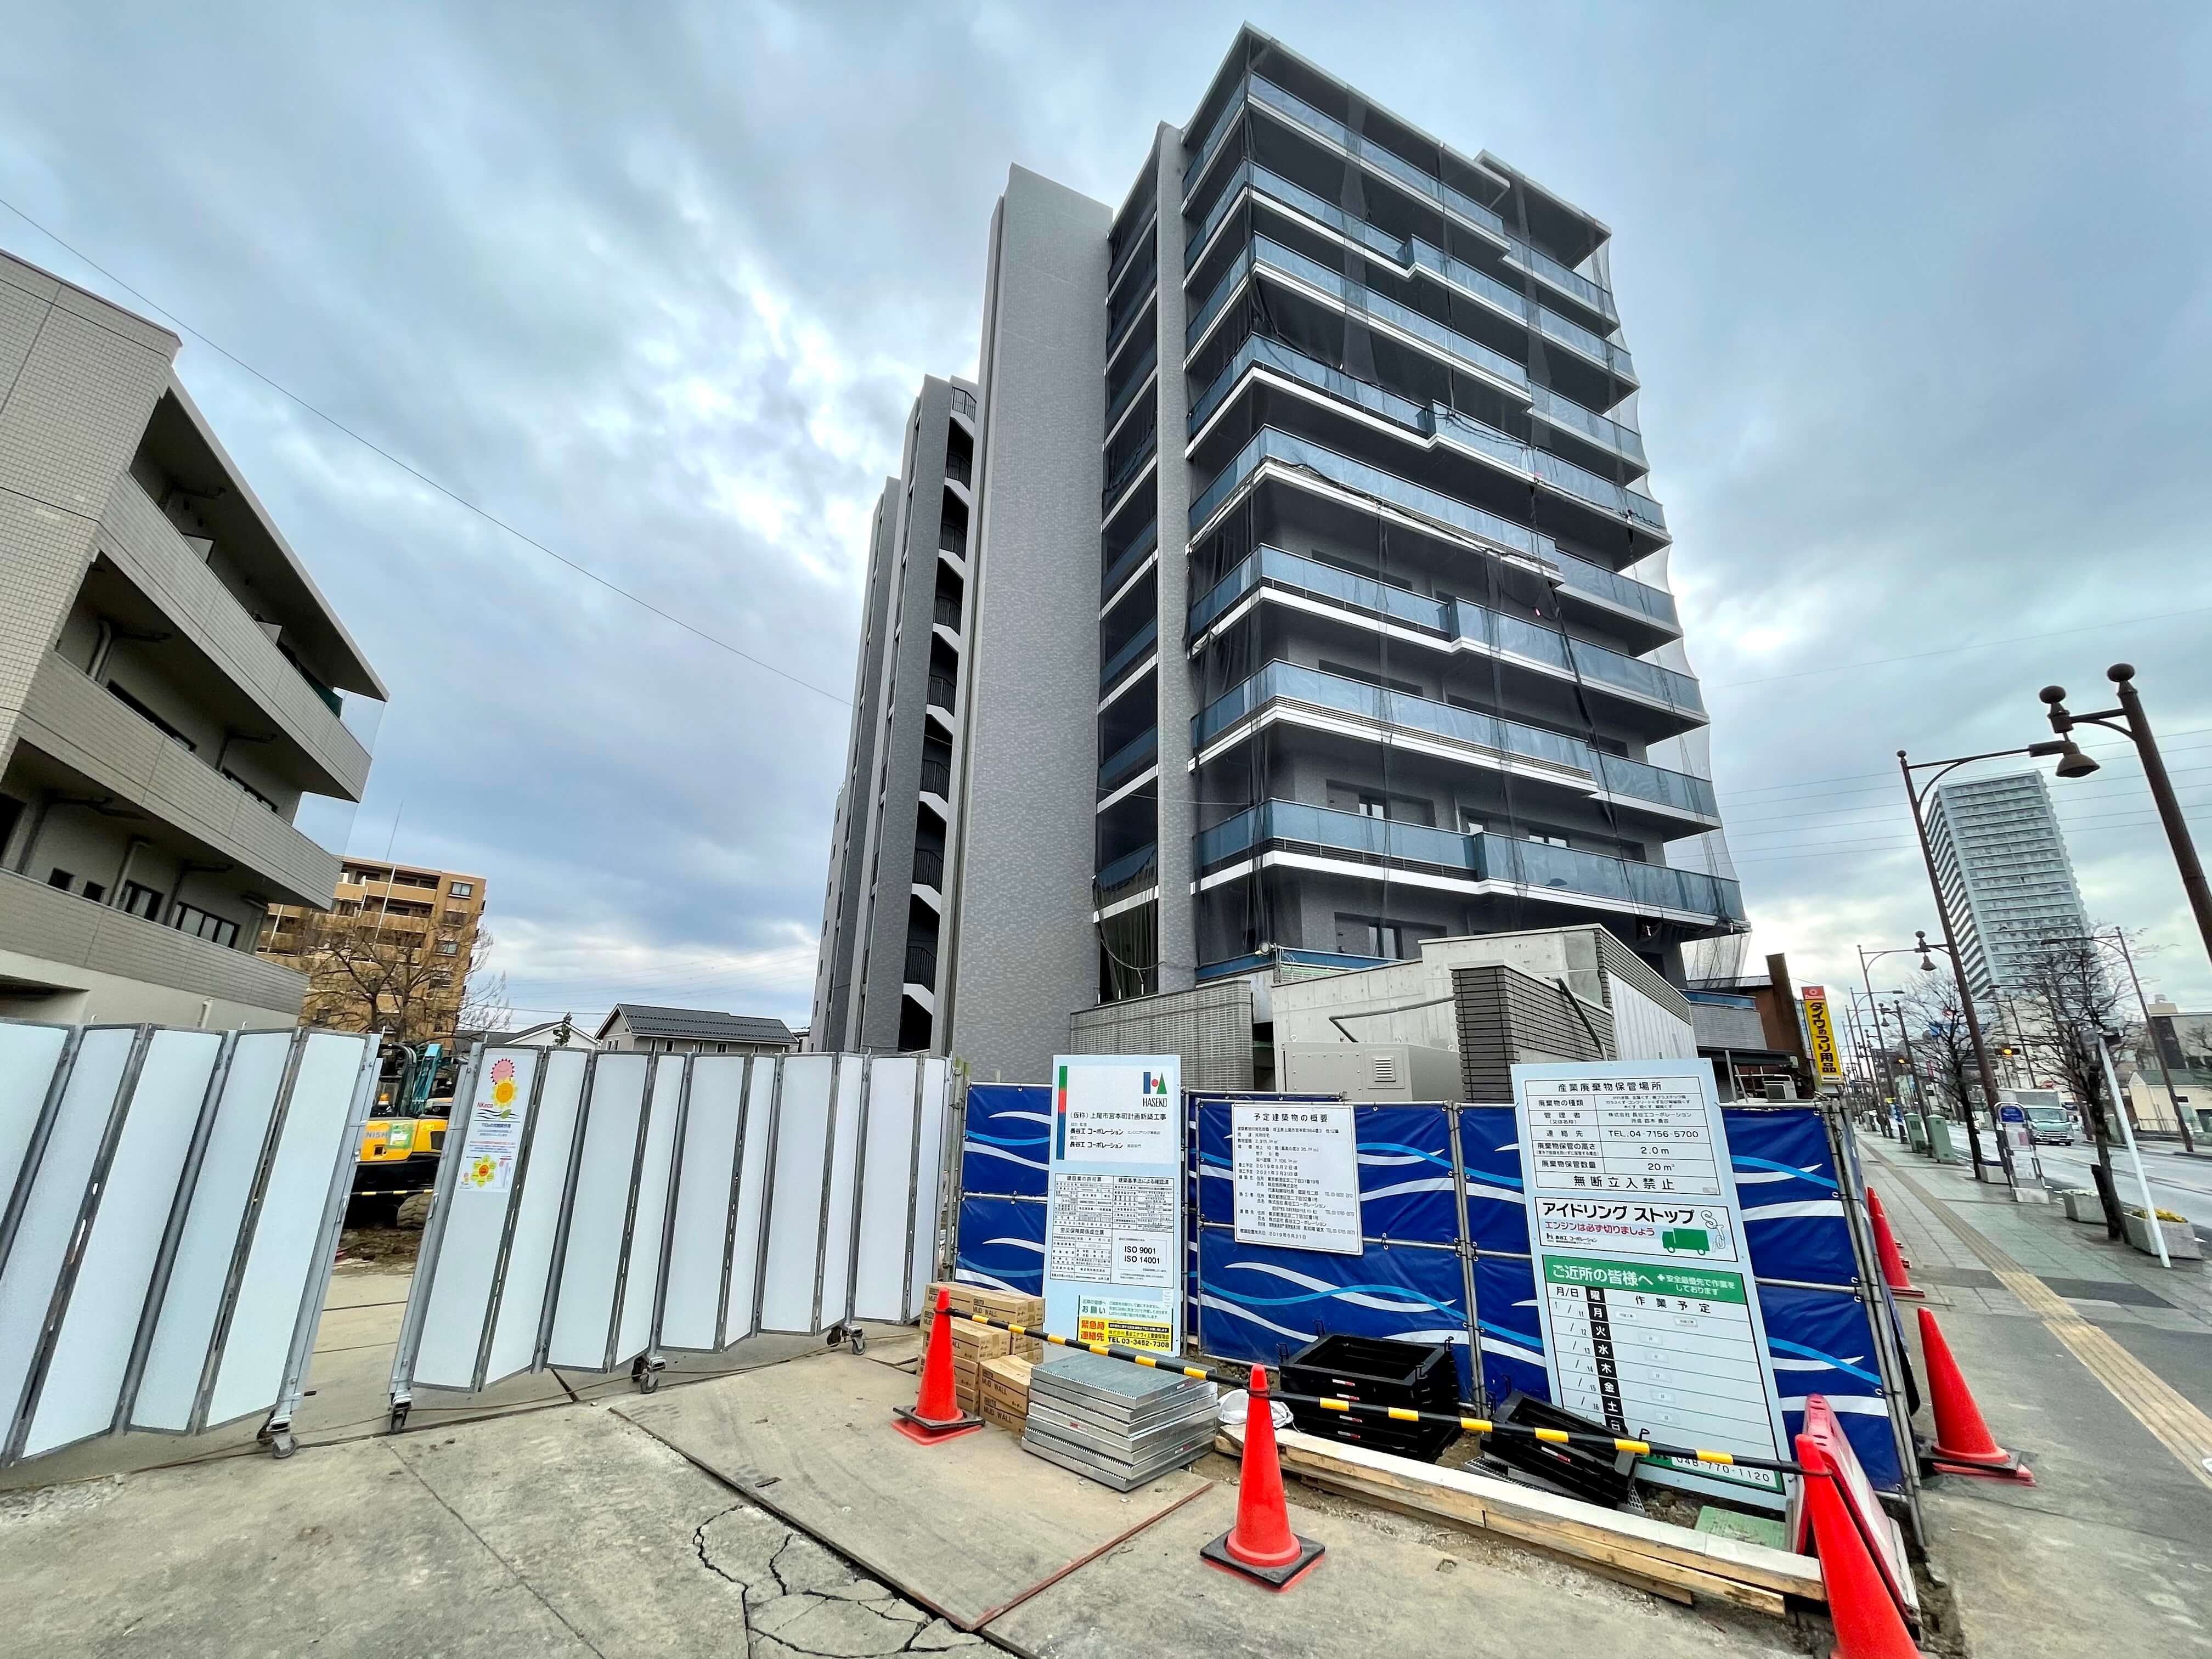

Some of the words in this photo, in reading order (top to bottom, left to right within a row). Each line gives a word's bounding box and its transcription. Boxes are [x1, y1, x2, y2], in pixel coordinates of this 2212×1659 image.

[1558, 1081, 1662, 1092] 産業廃棄物保管場所
[1143, 1098, 1167, 1107] HASEKO
[1254, 1113, 1328, 1122] 予定建築物の概要
[1542, 1160, 1596, 1169] 廃棄物保管数量
[1647, 1163, 1661, 1171] 20
[1573, 1175, 1675, 1190] 無断立入禁止
[1543, 1203, 1628, 1220] アイドリング
[1634, 1207, 1695, 1224] ストップ
[1544, 1221, 1655, 1236] エンジンは必ず切りましょう
[1139, 1246, 1155, 1255] 9001
[1140, 1256, 1160, 1265] 14001
[1552, 1265, 1654, 1286] ご近所の皆様へ
[1556, 1286, 1579, 1297] 月/日
[1675, 1284, 1718, 1295] しております
[1082, 1306, 1106, 1314] お願い
[1635, 1295, 1711, 1314] 作業予定
[1593, 1307, 1602, 1318] 月
[1081, 1320, 1105, 1330] 緊急時
[1595, 1325, 1606, 1336] 火
[1081, 1331, 1104, 1341] 連絡先
[1121, 1339, 1169, 1348] 03-3452-7308
[1598, 1344, 1609, 1355] 水
[1601, 1363, 1612, 1373] 木
[994, 1384, 1008, 1396] WALL
[1604, 1382, 1615, 1393] 金
[1607, 1401, 1618, 1412] 土
[984, 1406, 995, 1416] MUD
[997, 1411, 1013, 1424] WALL
